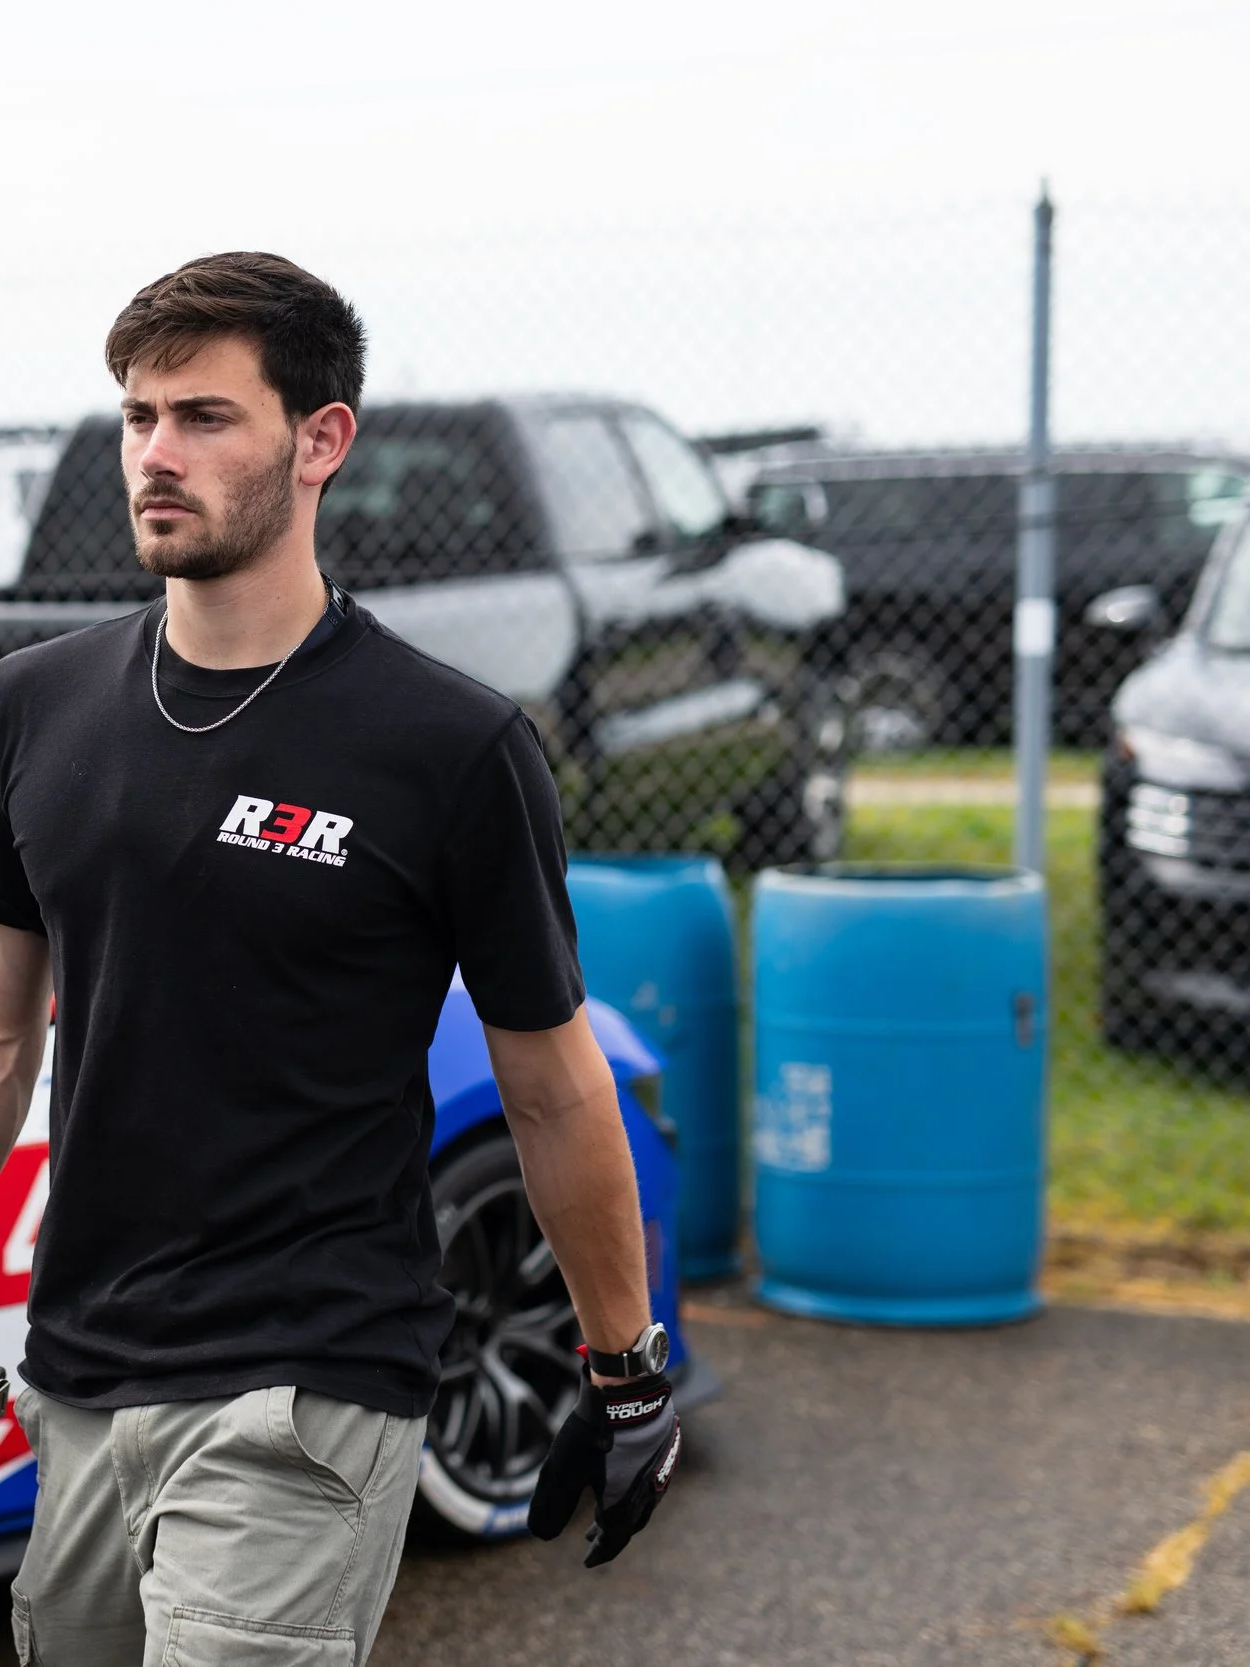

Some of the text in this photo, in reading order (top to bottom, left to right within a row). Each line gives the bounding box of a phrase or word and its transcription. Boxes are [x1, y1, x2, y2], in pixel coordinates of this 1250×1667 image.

[219, 795, 354, 854] R3R
[217, 831, 347, 867] ROUND 3 RACING
[606, 1401, 643, 1412] HYPER
[606, 1395, 666, 1420] TOUGH
